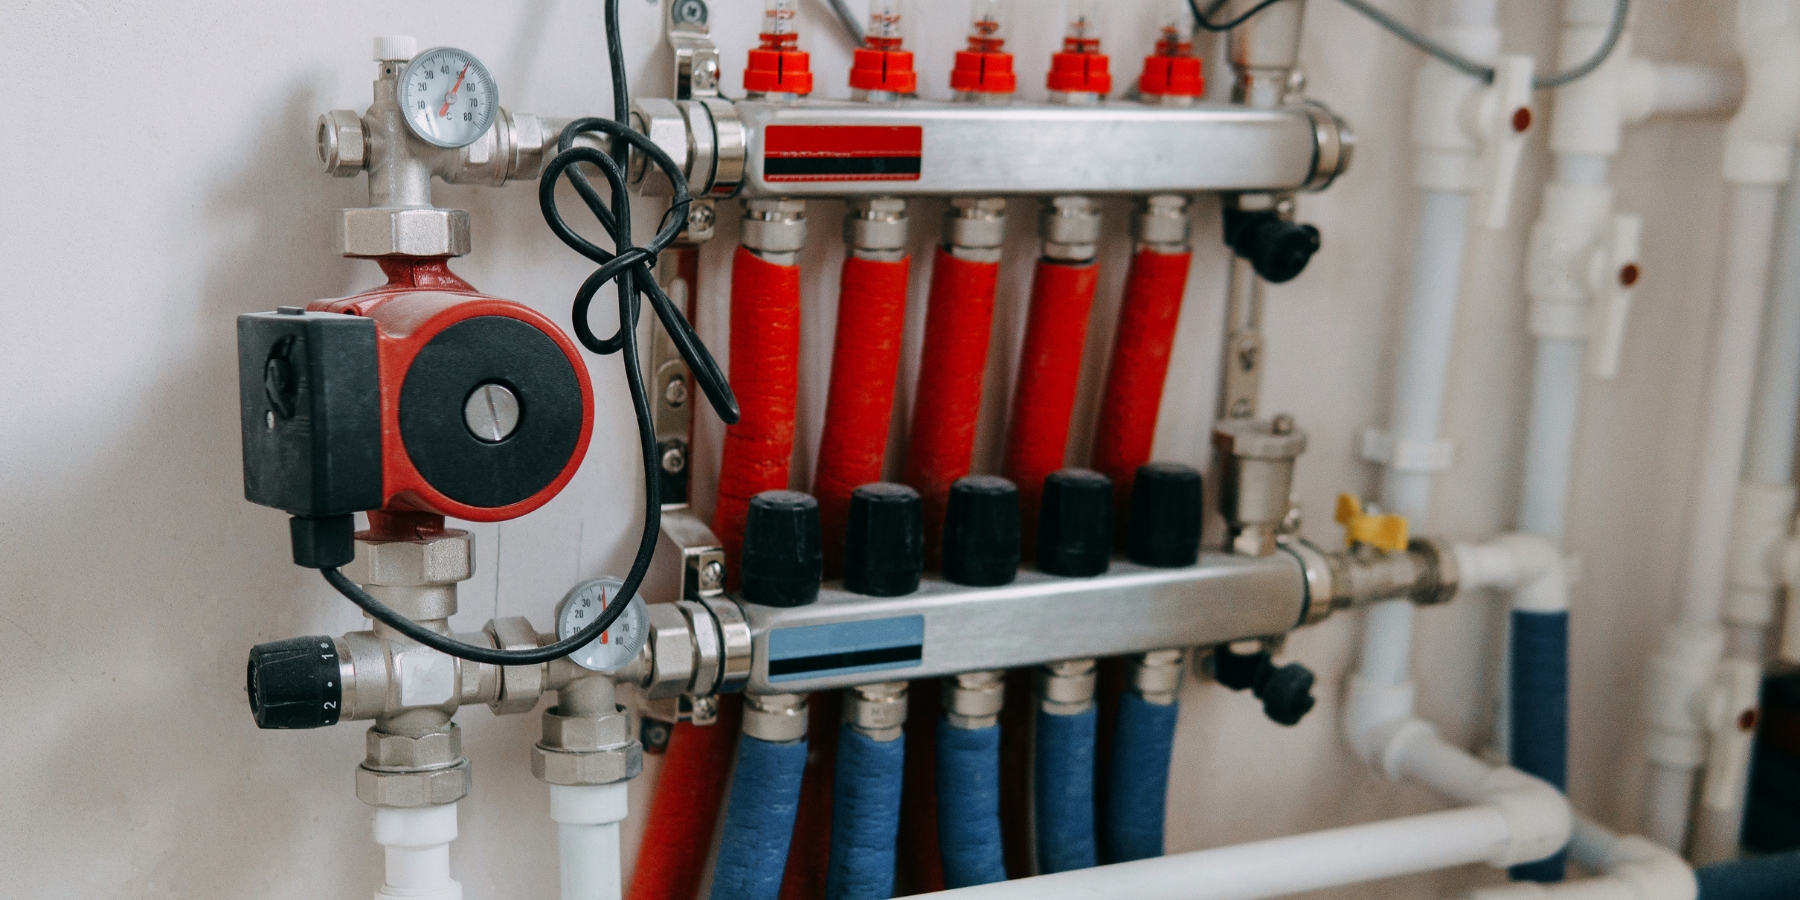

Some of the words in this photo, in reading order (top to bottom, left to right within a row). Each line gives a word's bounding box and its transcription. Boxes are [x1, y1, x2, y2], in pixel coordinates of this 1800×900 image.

[424, 70, 434, 79] 30
[441, 65, 450, 75] 40
[418, 82, 427, 92] 20
[466, 83, 475, 92] 60
[417, 100, 425, 109] 10
[469, 98, 478, 107] 70
[463, 112, 472, 121] 80
[582, 598, 591, 607] 30
[575, 610, 584, 619] 20
[573, 626, 581, 634] 10
[622, 623, 629, 632] 70
[615, 636, 623, 645] 80
[323, 701, 337, 710] 2
